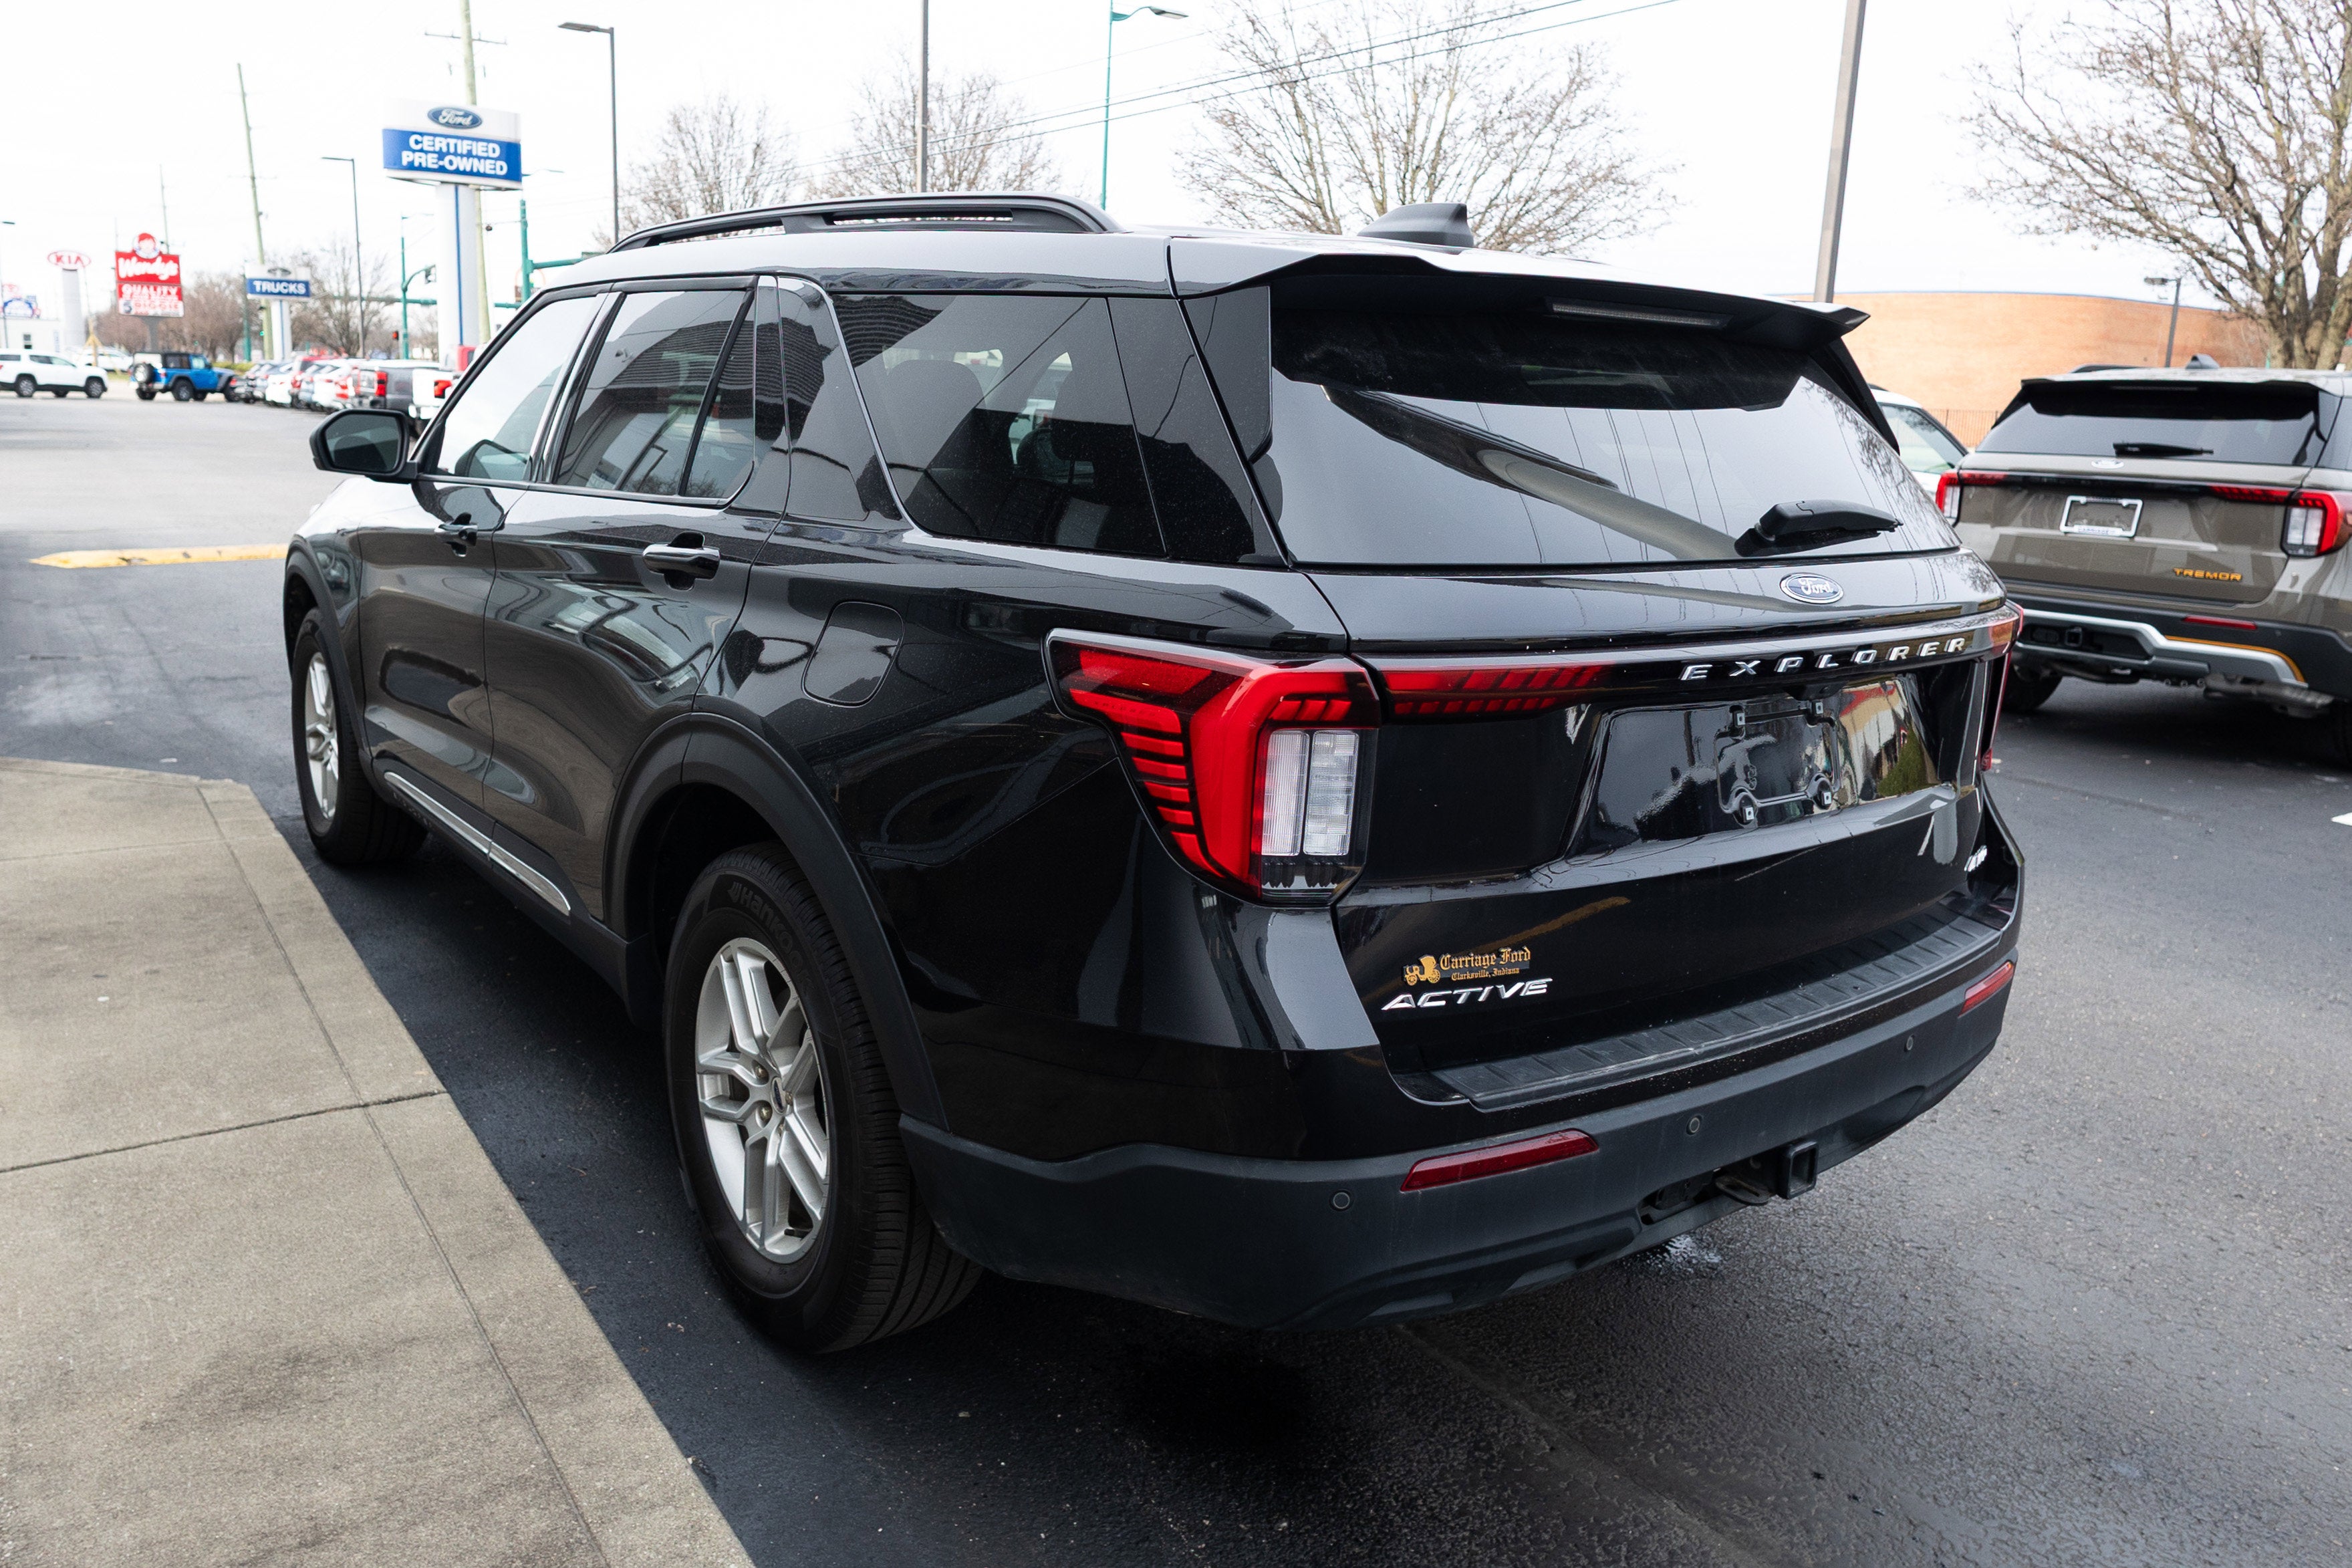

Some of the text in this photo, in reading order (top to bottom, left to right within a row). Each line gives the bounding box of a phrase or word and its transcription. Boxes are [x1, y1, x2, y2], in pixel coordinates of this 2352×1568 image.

[438, 109, 473, 126] Ford
[409, 134, 501, 158] CERTIFIED
[402, 151, 508, 176] PRE-OWNED
[56, 254, 85, 267] KIA
[122, 283, 178, 295] QUALITY
[253, 280, 307, 295] TRUCKS
[2173, 567, 2242, 581] TREMOR
[1798, 577, 1834, 595] Ford
[1680, 638, 1966, 680] EXPLORER
[1440, 946, 1531, 970] Carriage Ford
[1451, 967, 1520, 981] Clarksville, Indiana
[1381, 978, 1553, 1011] ACTIVE
